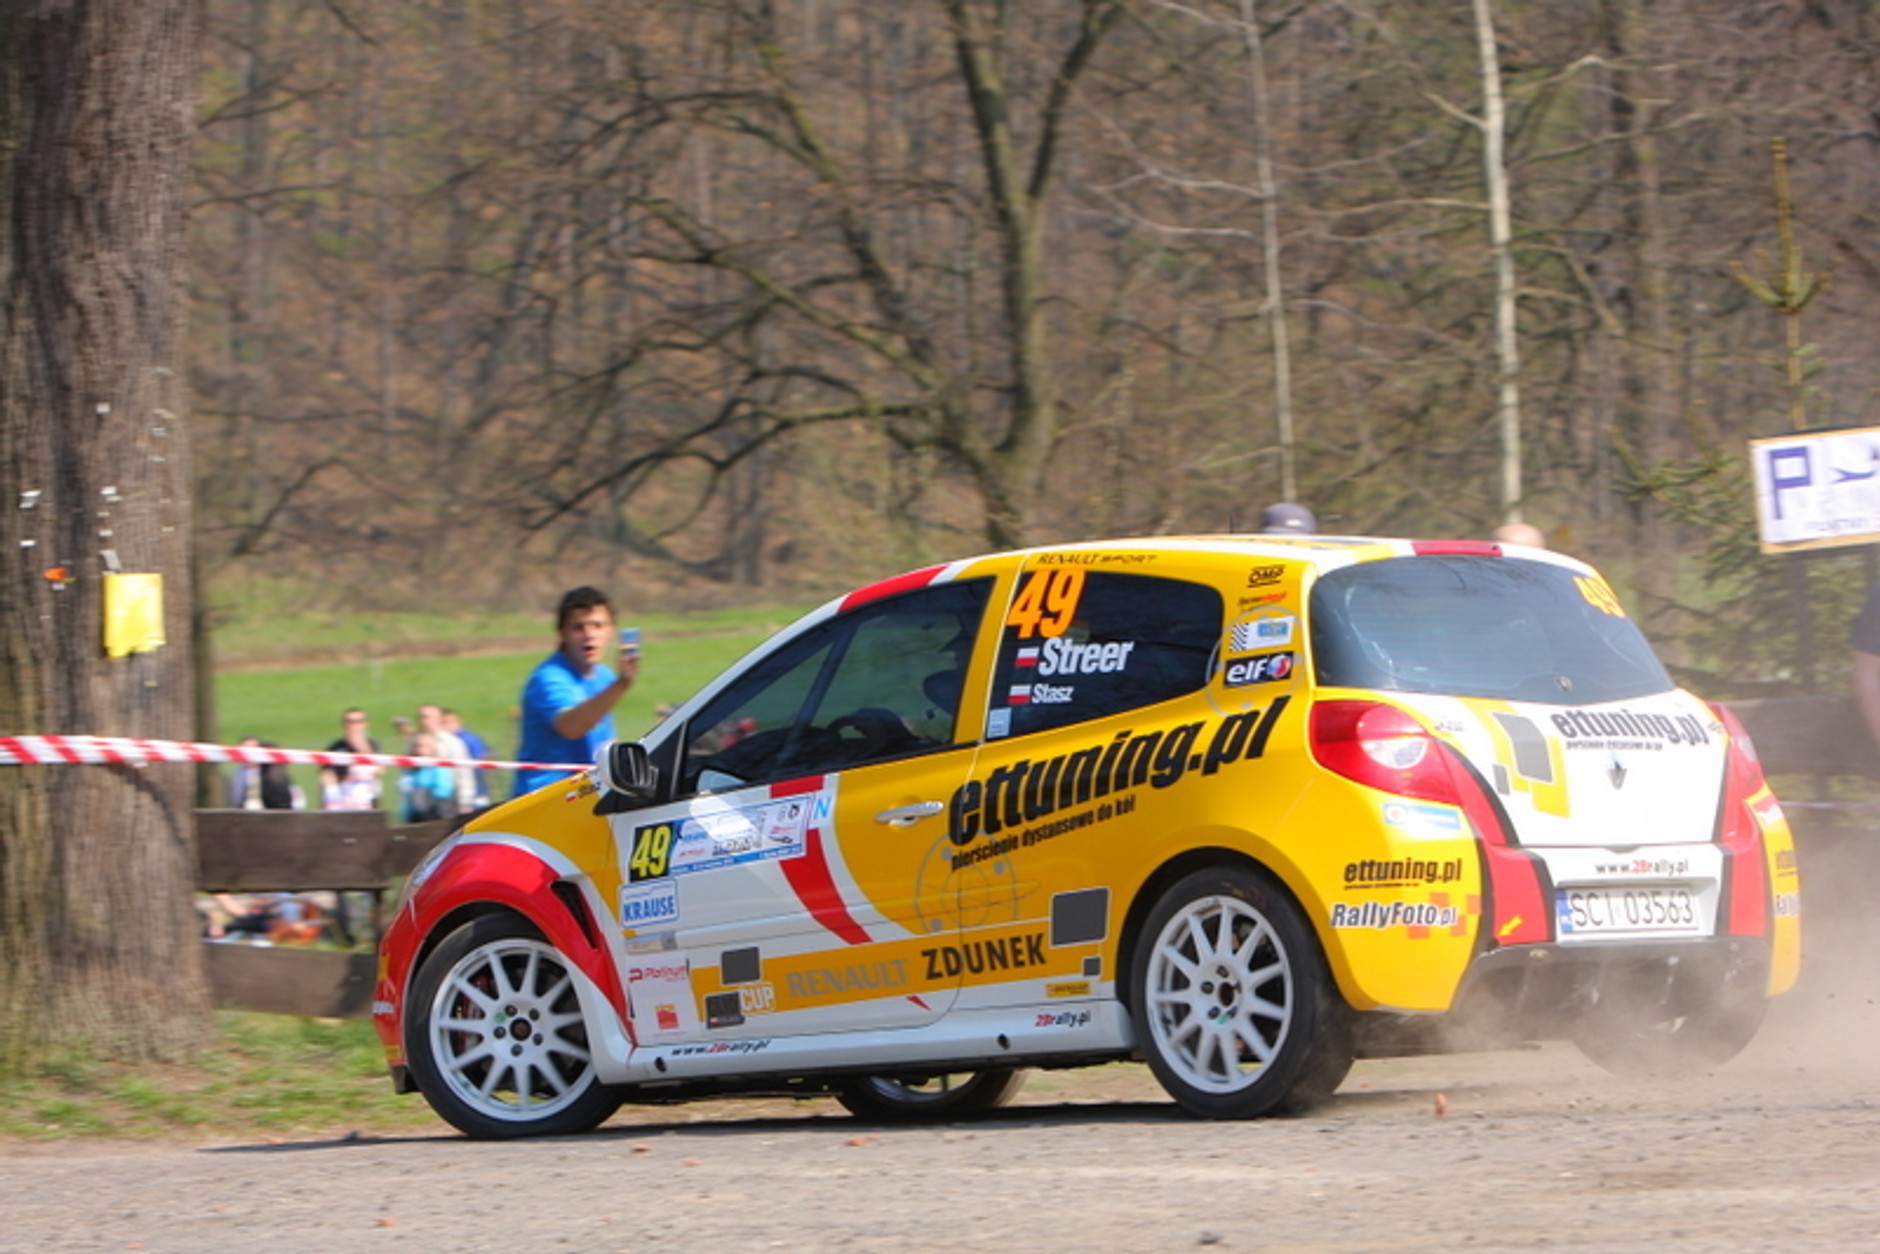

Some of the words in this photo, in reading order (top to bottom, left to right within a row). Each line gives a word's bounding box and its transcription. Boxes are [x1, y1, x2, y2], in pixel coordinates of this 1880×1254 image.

[1769, 445, 1812, 520] P
[1006, 567, 1087, 639] 49
[1038, 637, 1134, 675] Streer
[1226, 658, 1268, 683] elf
[1031, 683, 1074, 703] Stasz
[1550, 709, 1710, 746] ettuning.pl
[948, 695, 1291, 846] ettuning.pl
[814, 797, 832, 820] N
[1097, 803, 1113, 822] do
[629, 825, 671, 878] 49
[1344, 857, 1462, 883] ettuning.pl
[623, 895, 676, 922] KRAUSE
[1331, 902, 1457, 928] RallyFoto.pl
[785, 960, 909, 997] RENAULT
[921, 933, 1047, 980] ZDUNEK
[740, 986, 774, 1011] CUP
